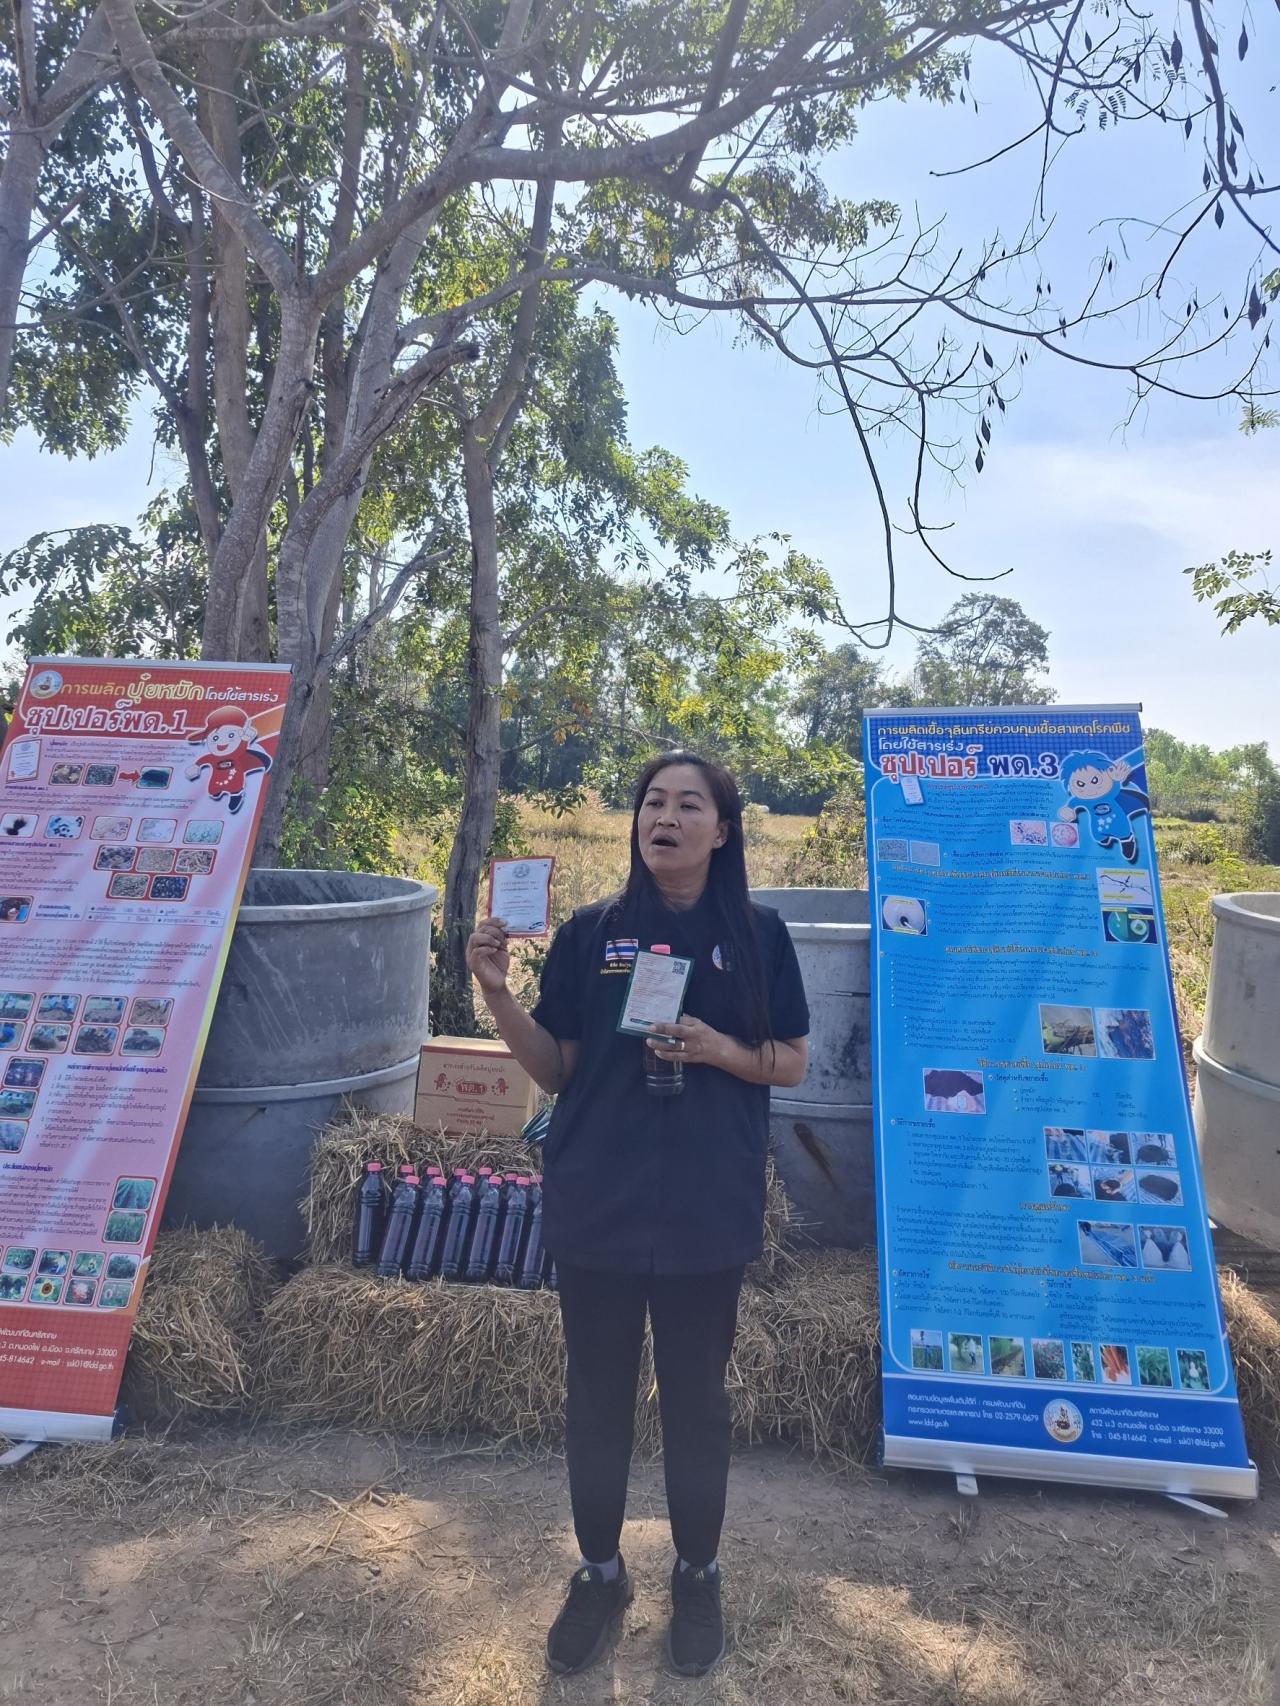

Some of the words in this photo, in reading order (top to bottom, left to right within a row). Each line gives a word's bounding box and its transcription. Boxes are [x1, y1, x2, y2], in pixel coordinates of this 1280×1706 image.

[878, 736, 964, 752] โดยใช้สารเร่ง
[95, 1348, 118, 1357] 33000
[1203, 1425, 1225, 1435] 33000
